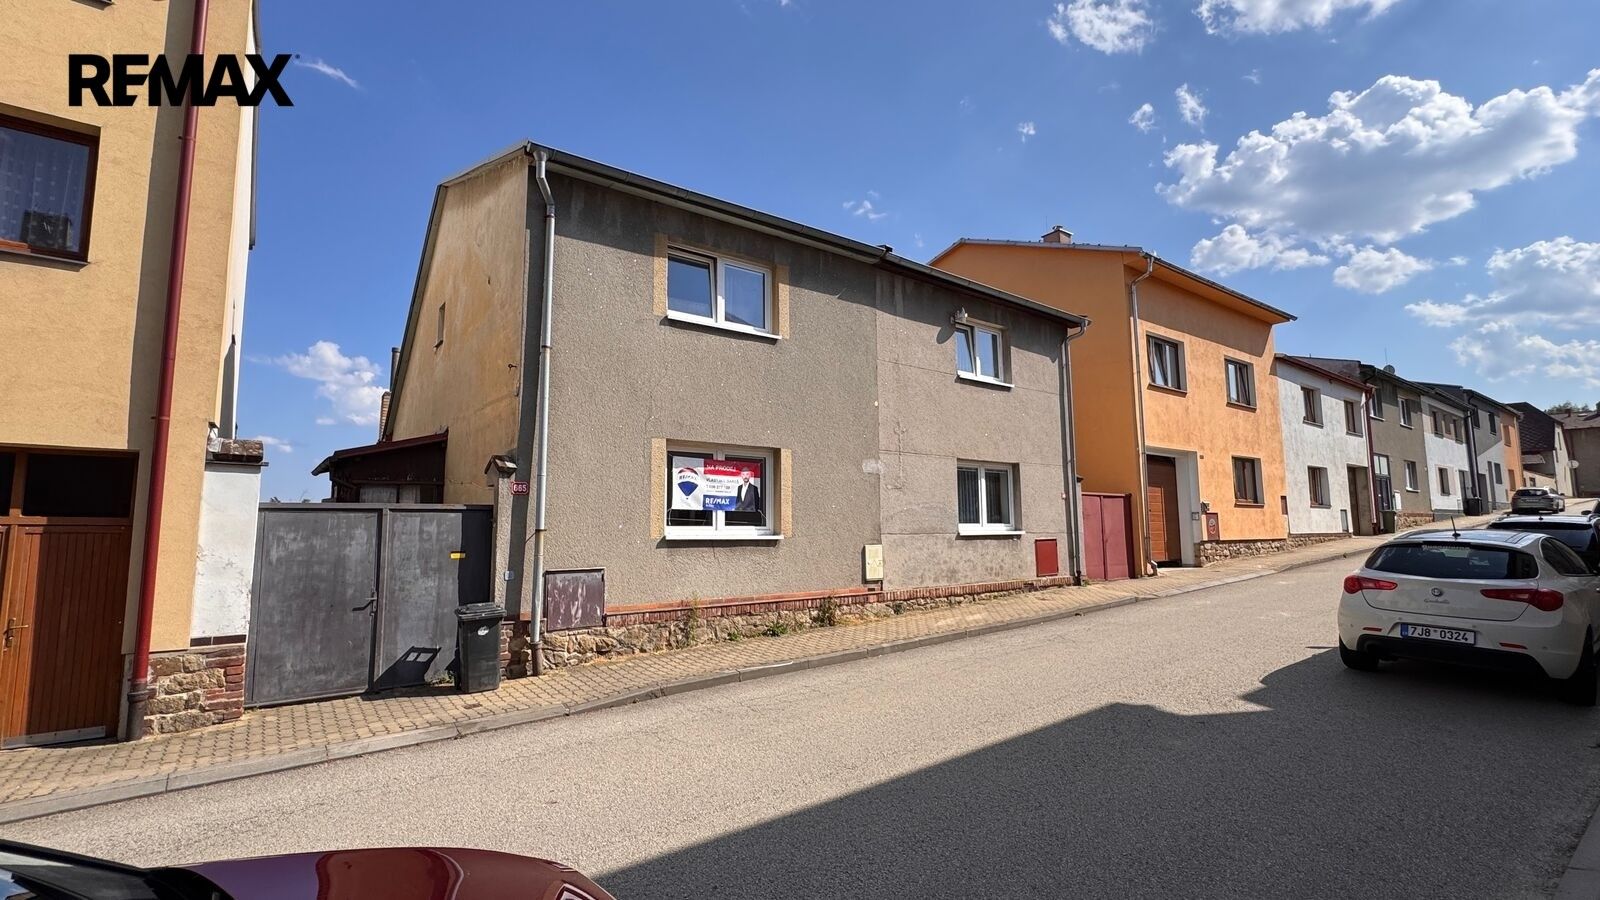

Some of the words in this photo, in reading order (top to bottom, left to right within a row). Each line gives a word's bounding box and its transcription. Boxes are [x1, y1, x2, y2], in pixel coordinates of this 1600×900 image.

[705, 497, 730, 505] RE/MAX
[1410, 626, 1431, 637] 7J8
[1440, 630, 1469, 642] 0324
